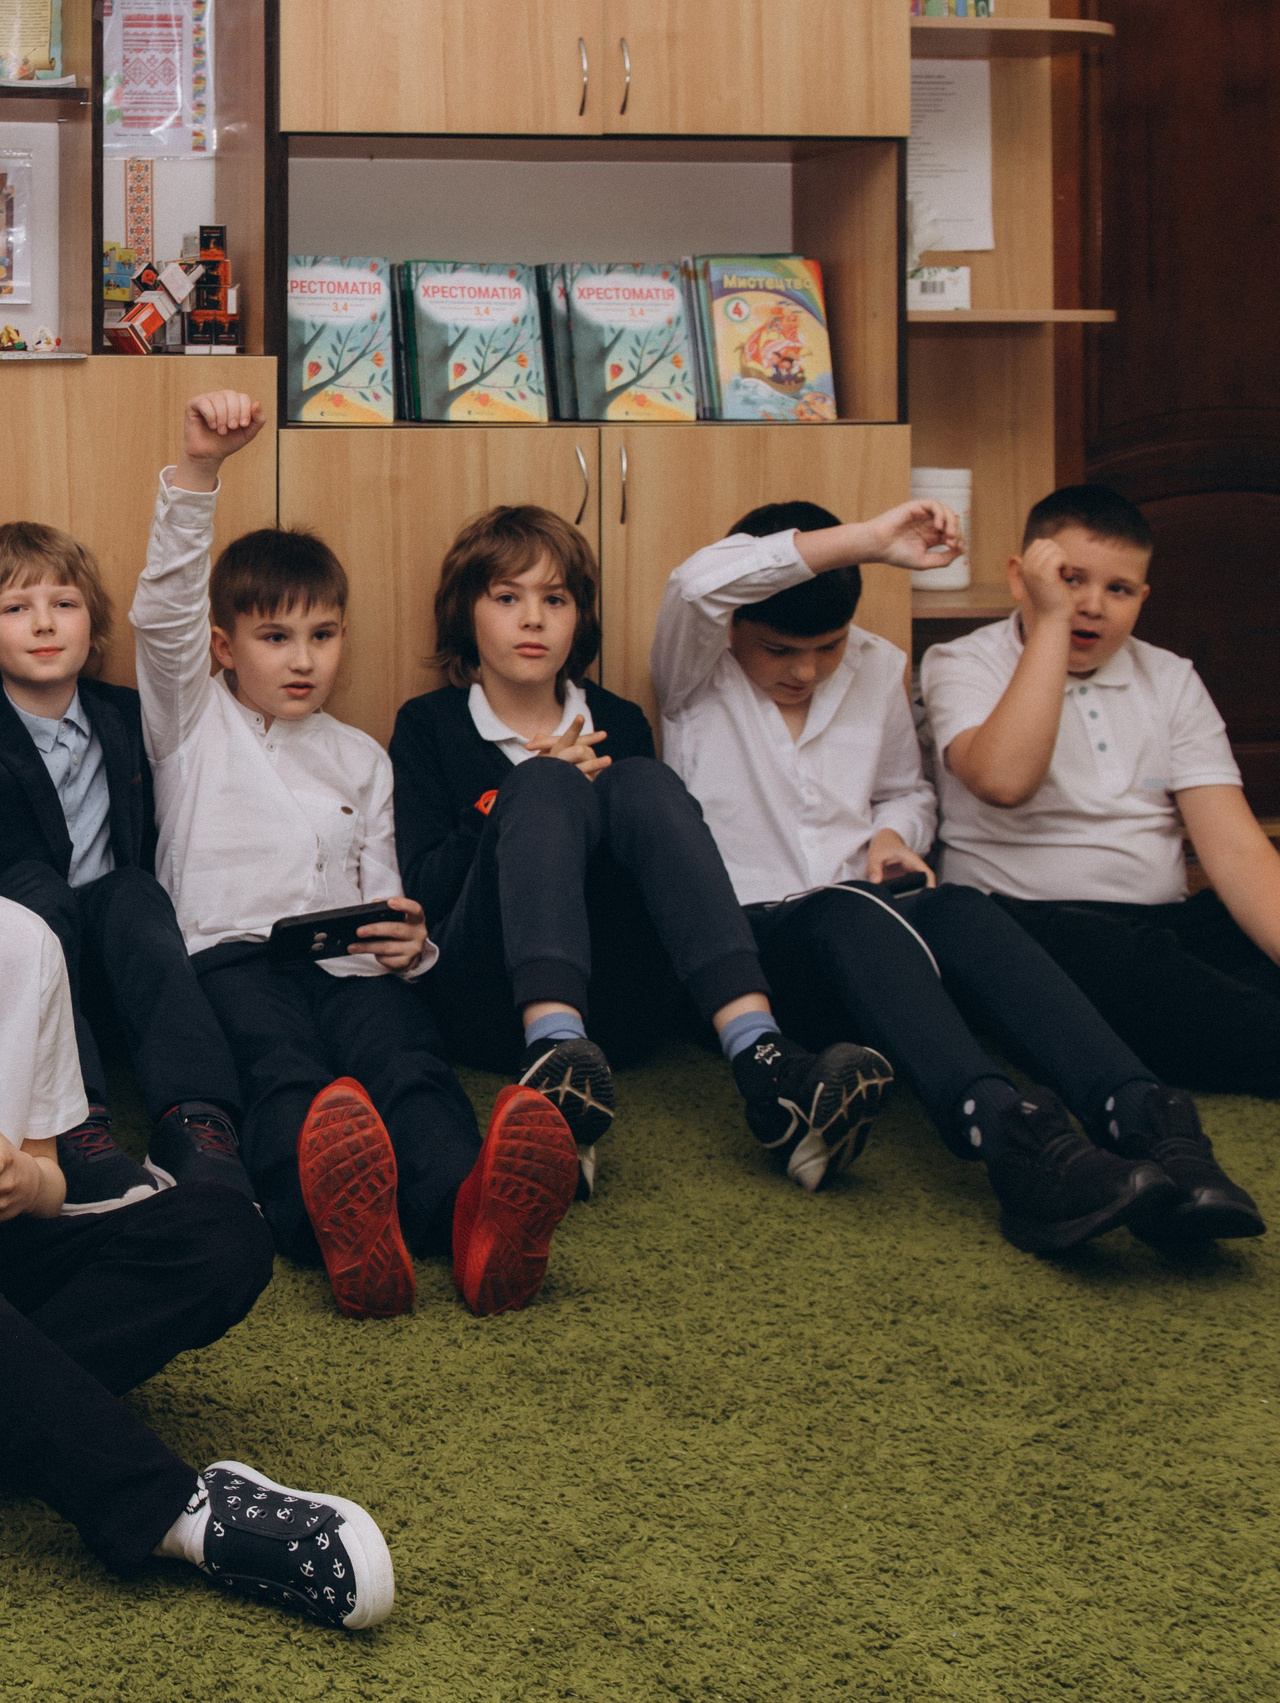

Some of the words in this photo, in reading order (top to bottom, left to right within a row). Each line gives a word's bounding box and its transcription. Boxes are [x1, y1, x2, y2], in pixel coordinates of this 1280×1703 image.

[421, 285, 521, 300] ХРЕСТОМАТІЯ
[577, 286, 676, 301] ХРЕСТОМАТІЯ
[732, 301, 743, 318] 4
